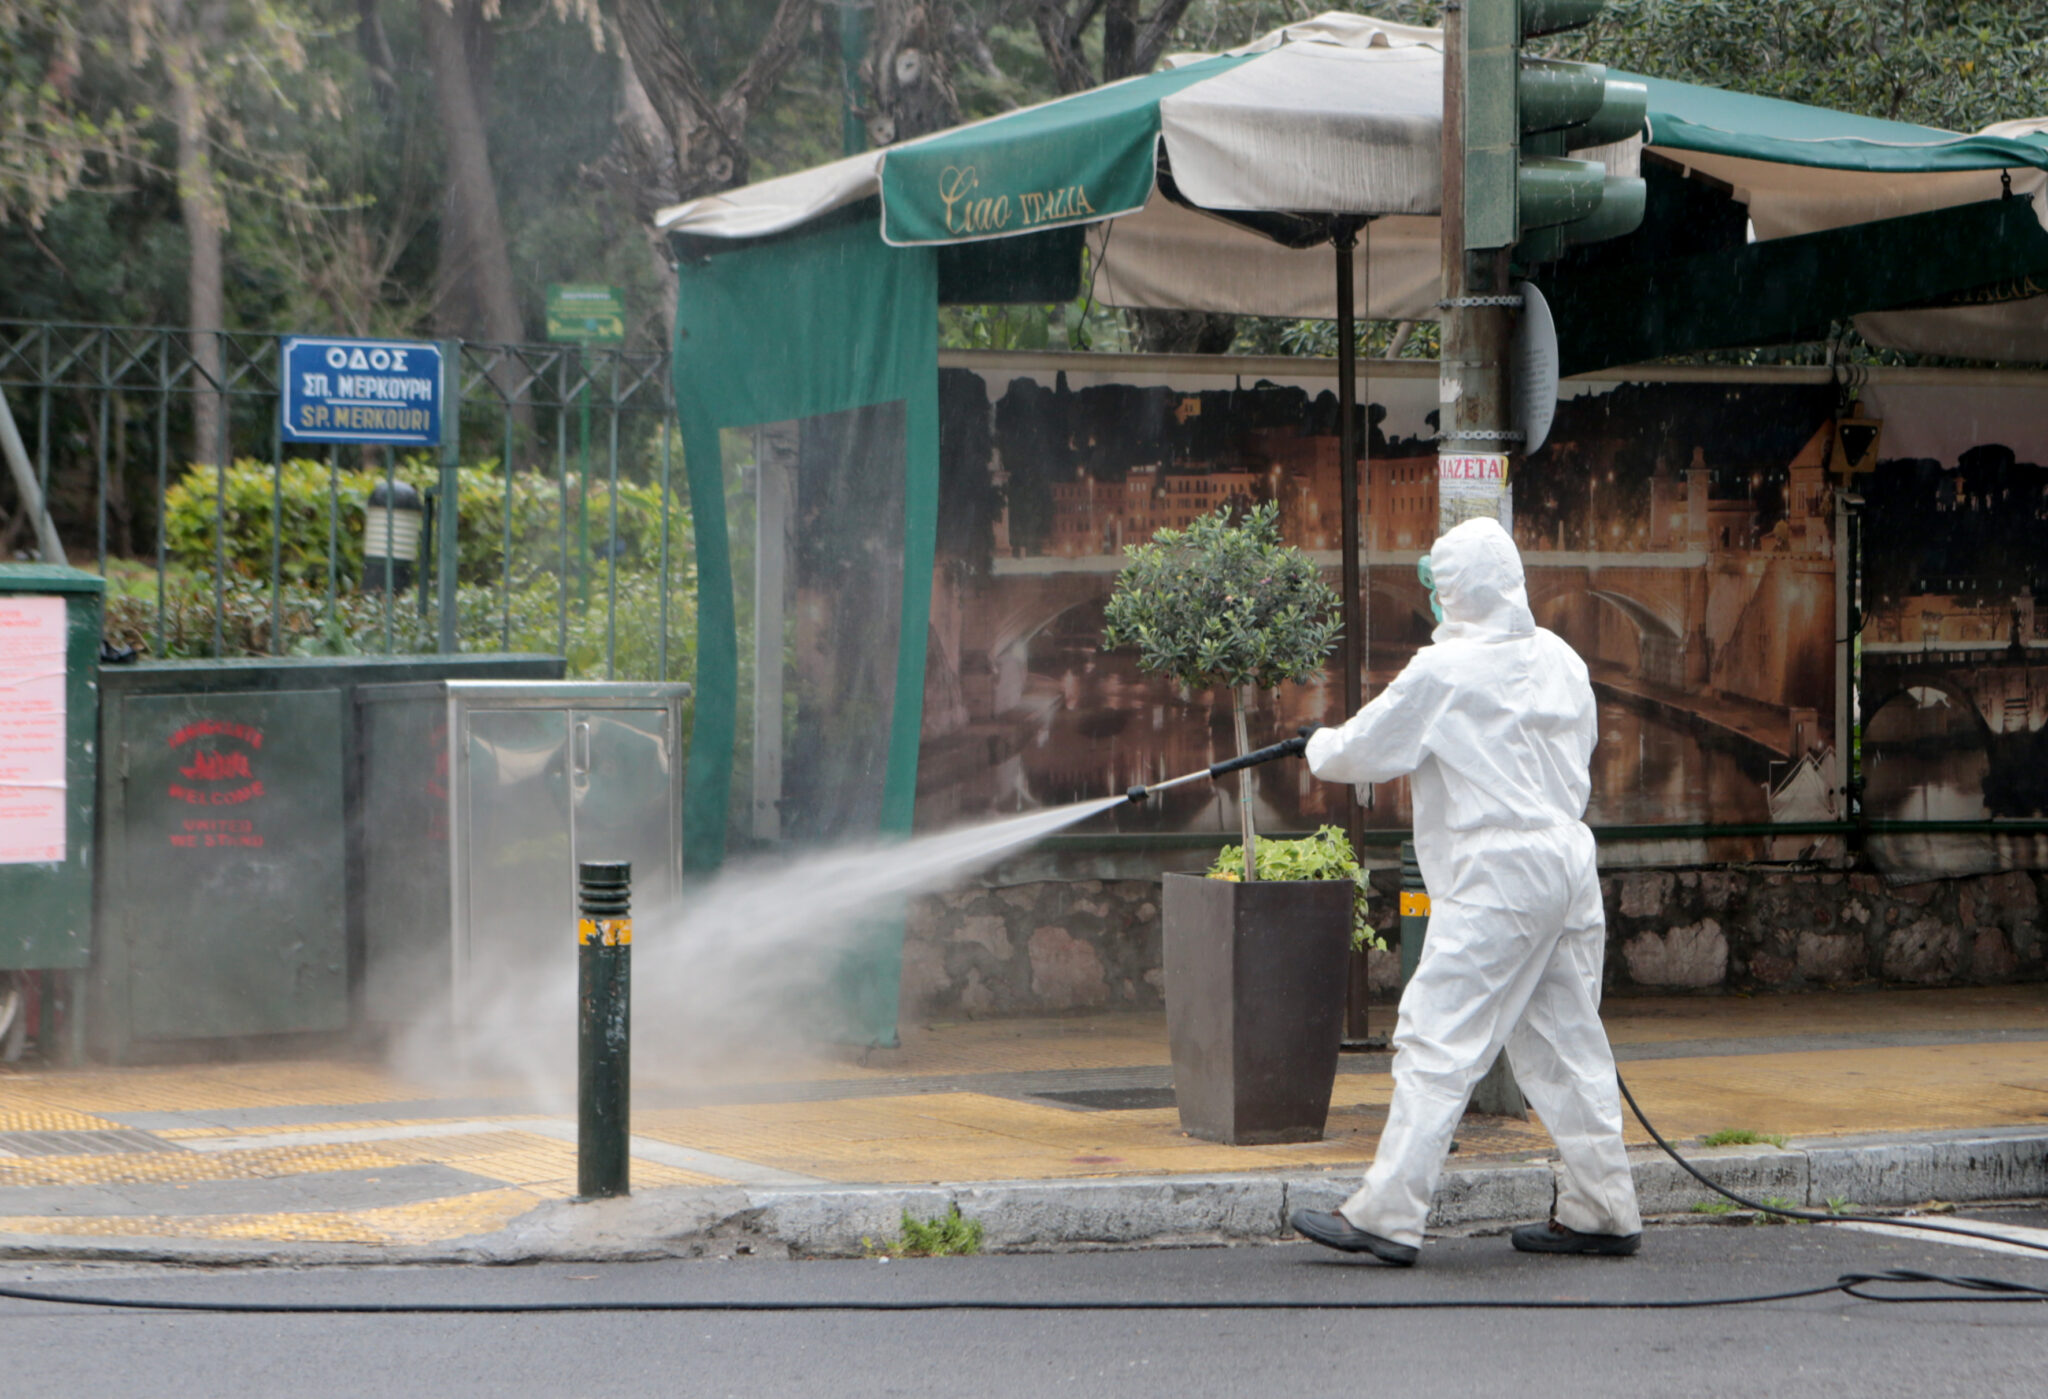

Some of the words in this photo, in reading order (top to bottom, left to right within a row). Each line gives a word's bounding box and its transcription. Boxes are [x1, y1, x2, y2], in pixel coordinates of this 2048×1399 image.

[939, 165, 1012, 234] Ciao
[1019, 184, 1096, 225] ITALIA
[325, 347, 409, 371] ΟΔΟΣ
[302, 373, 333, 397] ΣΠ.
[338, 374, 432, 401] ΜΕΡΚΟΥΡΗ
[301, 405, 331, 428] SP.
[334, 406, 431, 431] MERKOURI
[168, 780, 265, 806] WELCOME
[169, 834, 198, 848] WE
